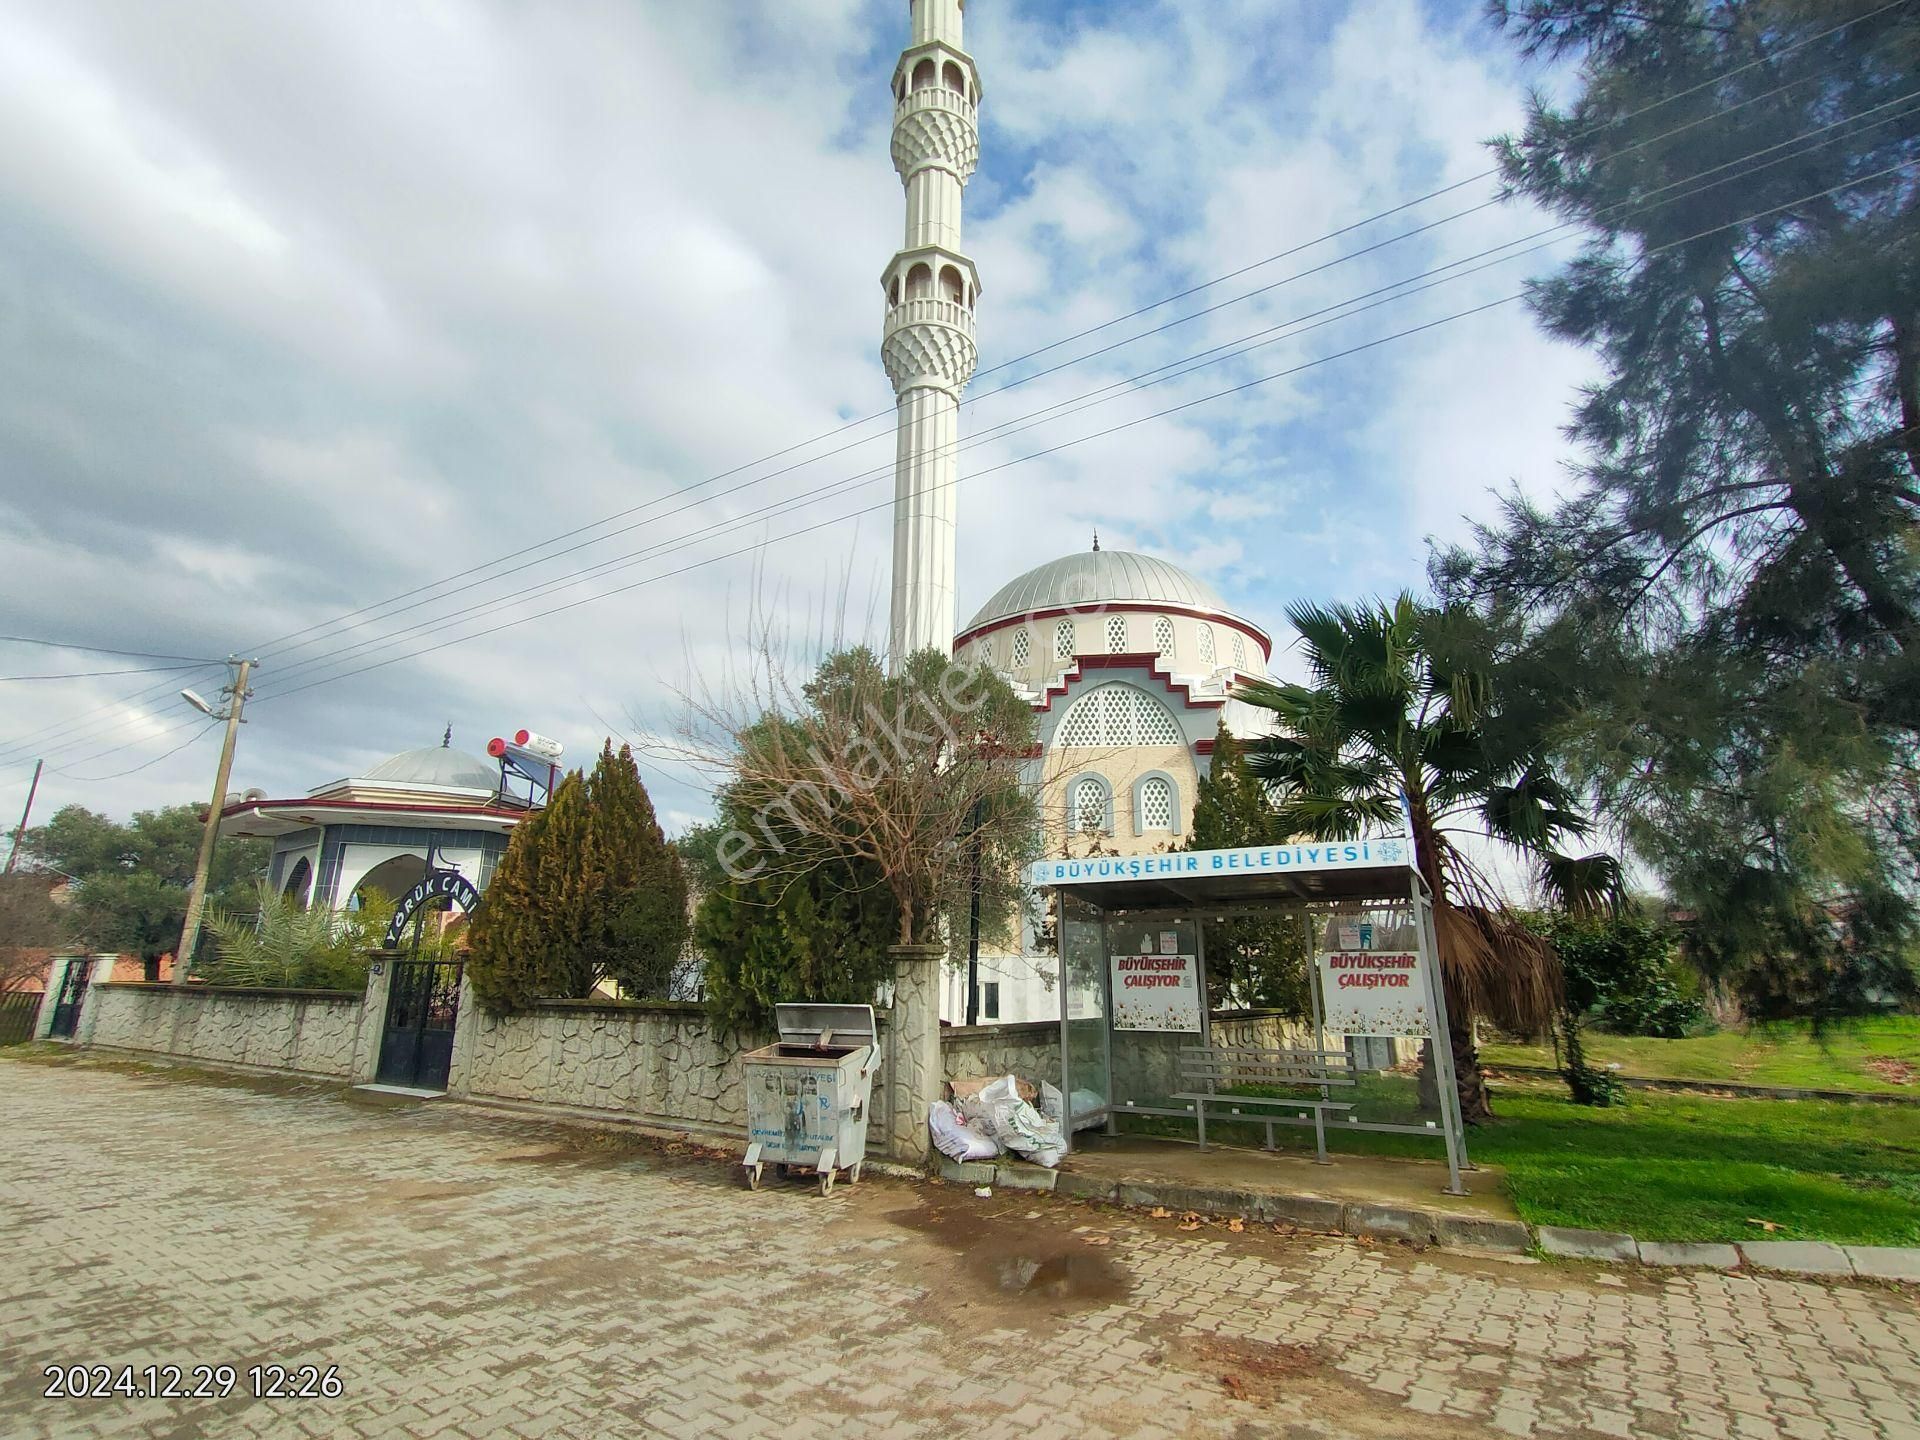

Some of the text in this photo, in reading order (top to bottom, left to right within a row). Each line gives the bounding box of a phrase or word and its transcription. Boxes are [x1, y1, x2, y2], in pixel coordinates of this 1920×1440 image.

[1056, 842, 1369, 878] BÜYÜKŞEHİR BELEDİYESİ
[386, 879, 434, 941] YÖRÜK
[1118, 956, 1187, 973] BÜYÜKŞEHİR
[1330, 953, 1416, 972] BÜYÜKŞEHİR
[1124, 975, 1181, 989] ÇALIŞIYOR
[1338, 974, 1409, 989] ÇALIŞIYOR
